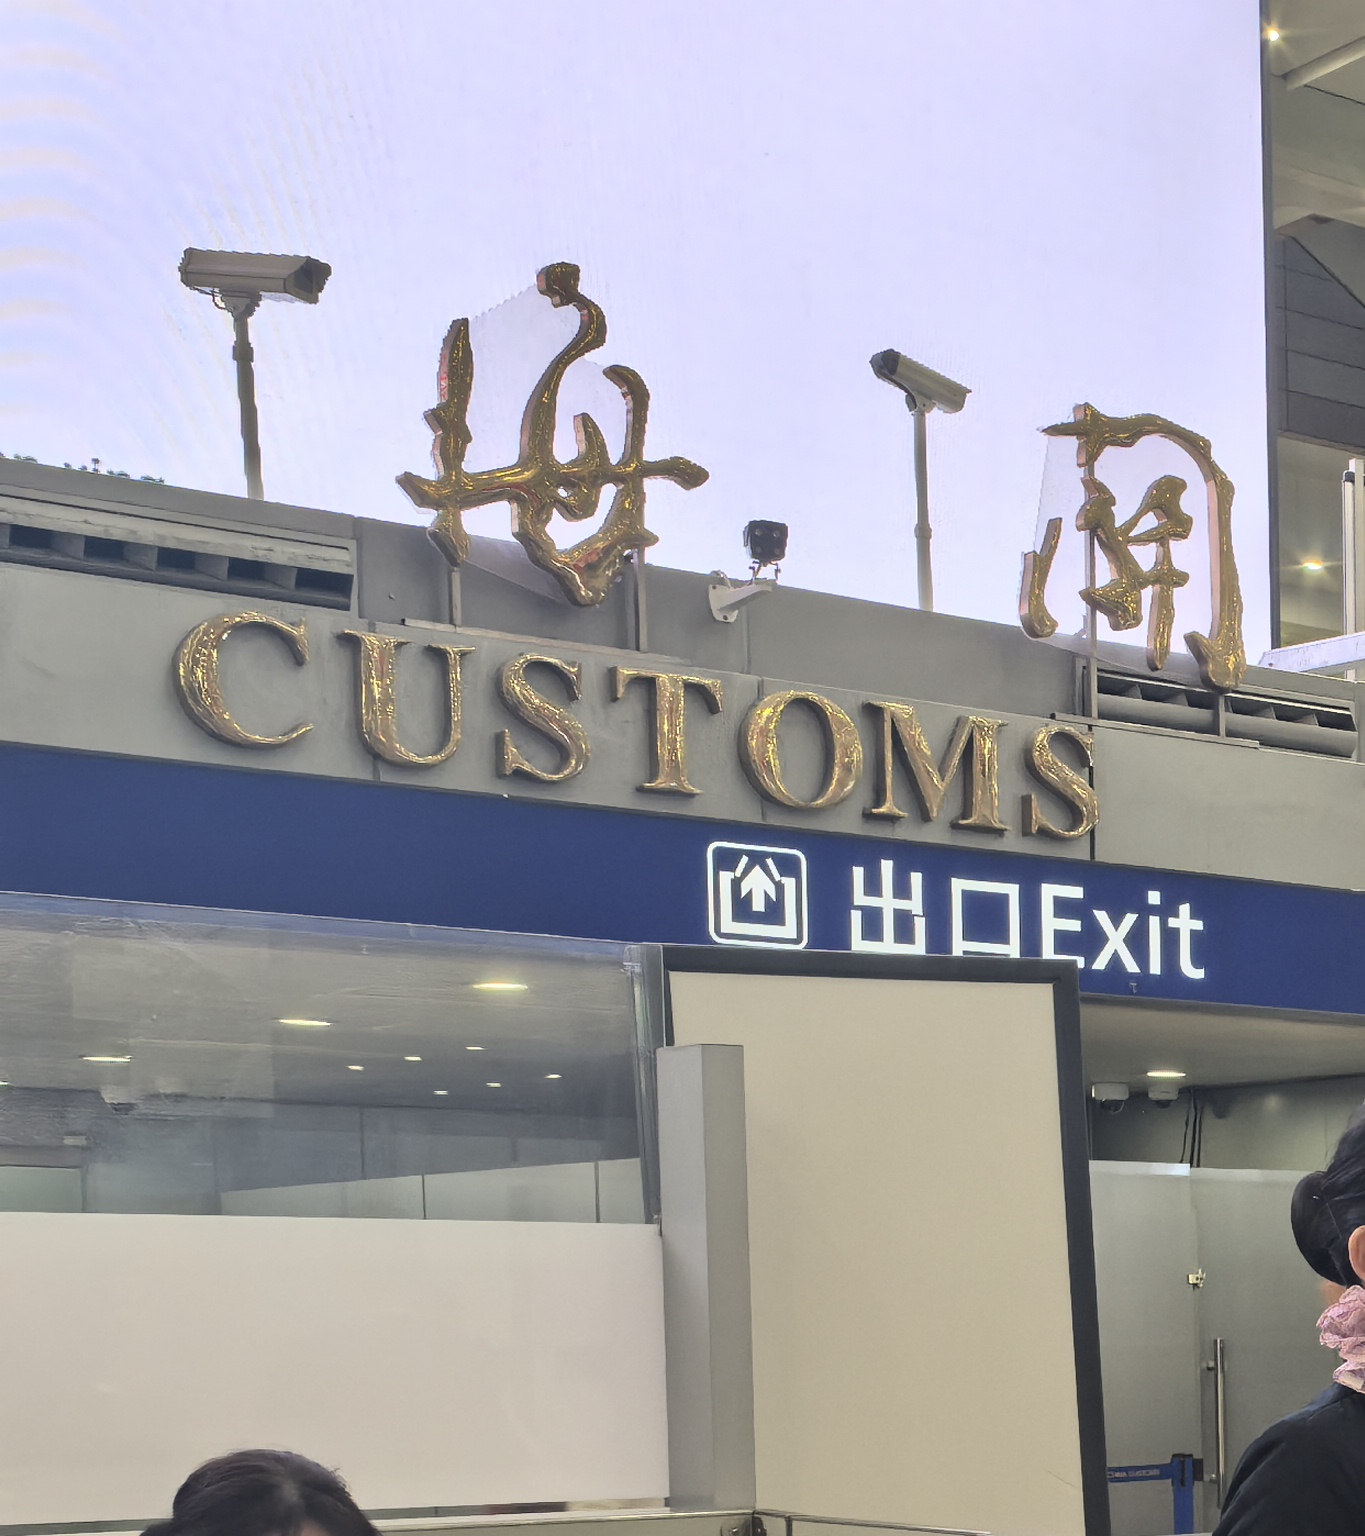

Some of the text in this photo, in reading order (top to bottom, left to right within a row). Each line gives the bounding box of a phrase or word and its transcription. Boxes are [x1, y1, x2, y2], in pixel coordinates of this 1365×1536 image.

[170, 609, 1100, 840] CUSTOMS
[850, 857, 1206, 979] 出口 Exit
